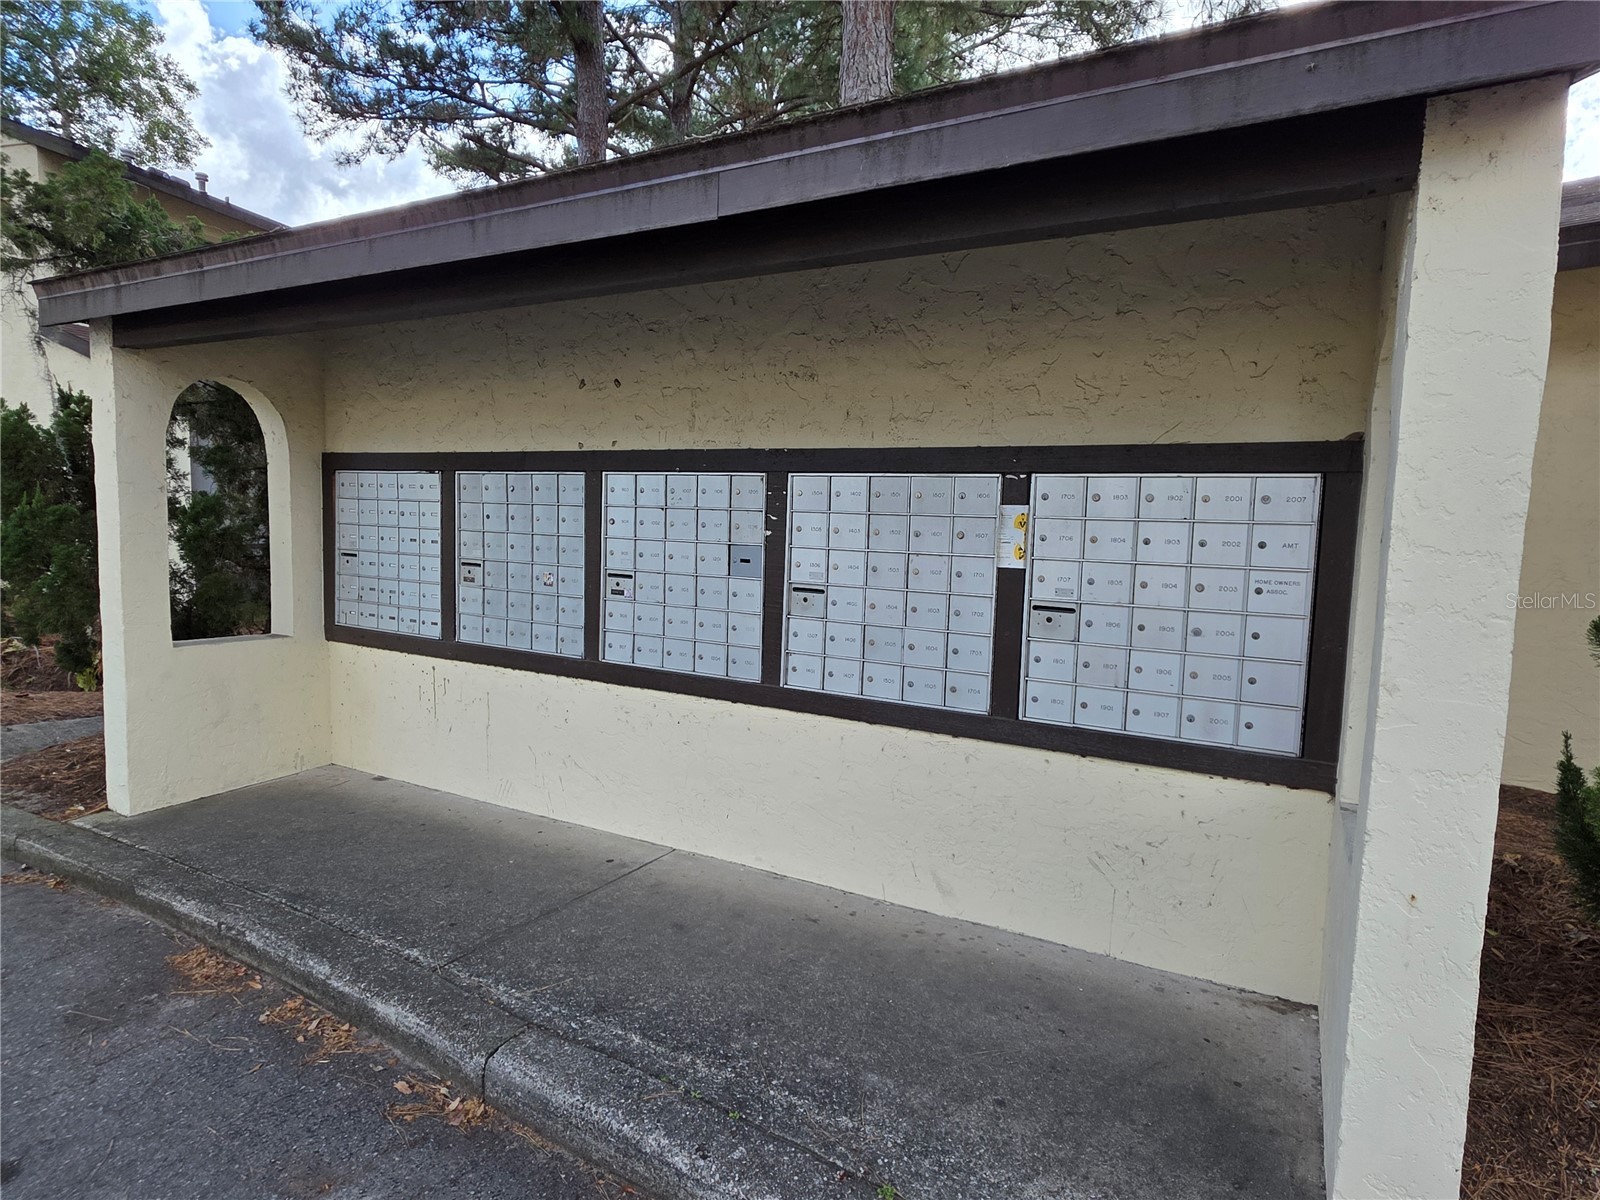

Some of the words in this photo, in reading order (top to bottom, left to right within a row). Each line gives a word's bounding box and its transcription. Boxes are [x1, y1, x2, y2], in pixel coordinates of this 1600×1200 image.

[1167, 494, 1184, 502] 1902
[1164, 538, 1181, 546] 1903
[1221, 540, 1241, 548] 2002
[1218, 585, 1238, 593] 2003
[1158, 625, 1175, 633] 1905
[1156, 668, 1172, 676] 1906
[1212, 674, 1232, 682] 2005
[1050, 698, 1065, 706] 1802
